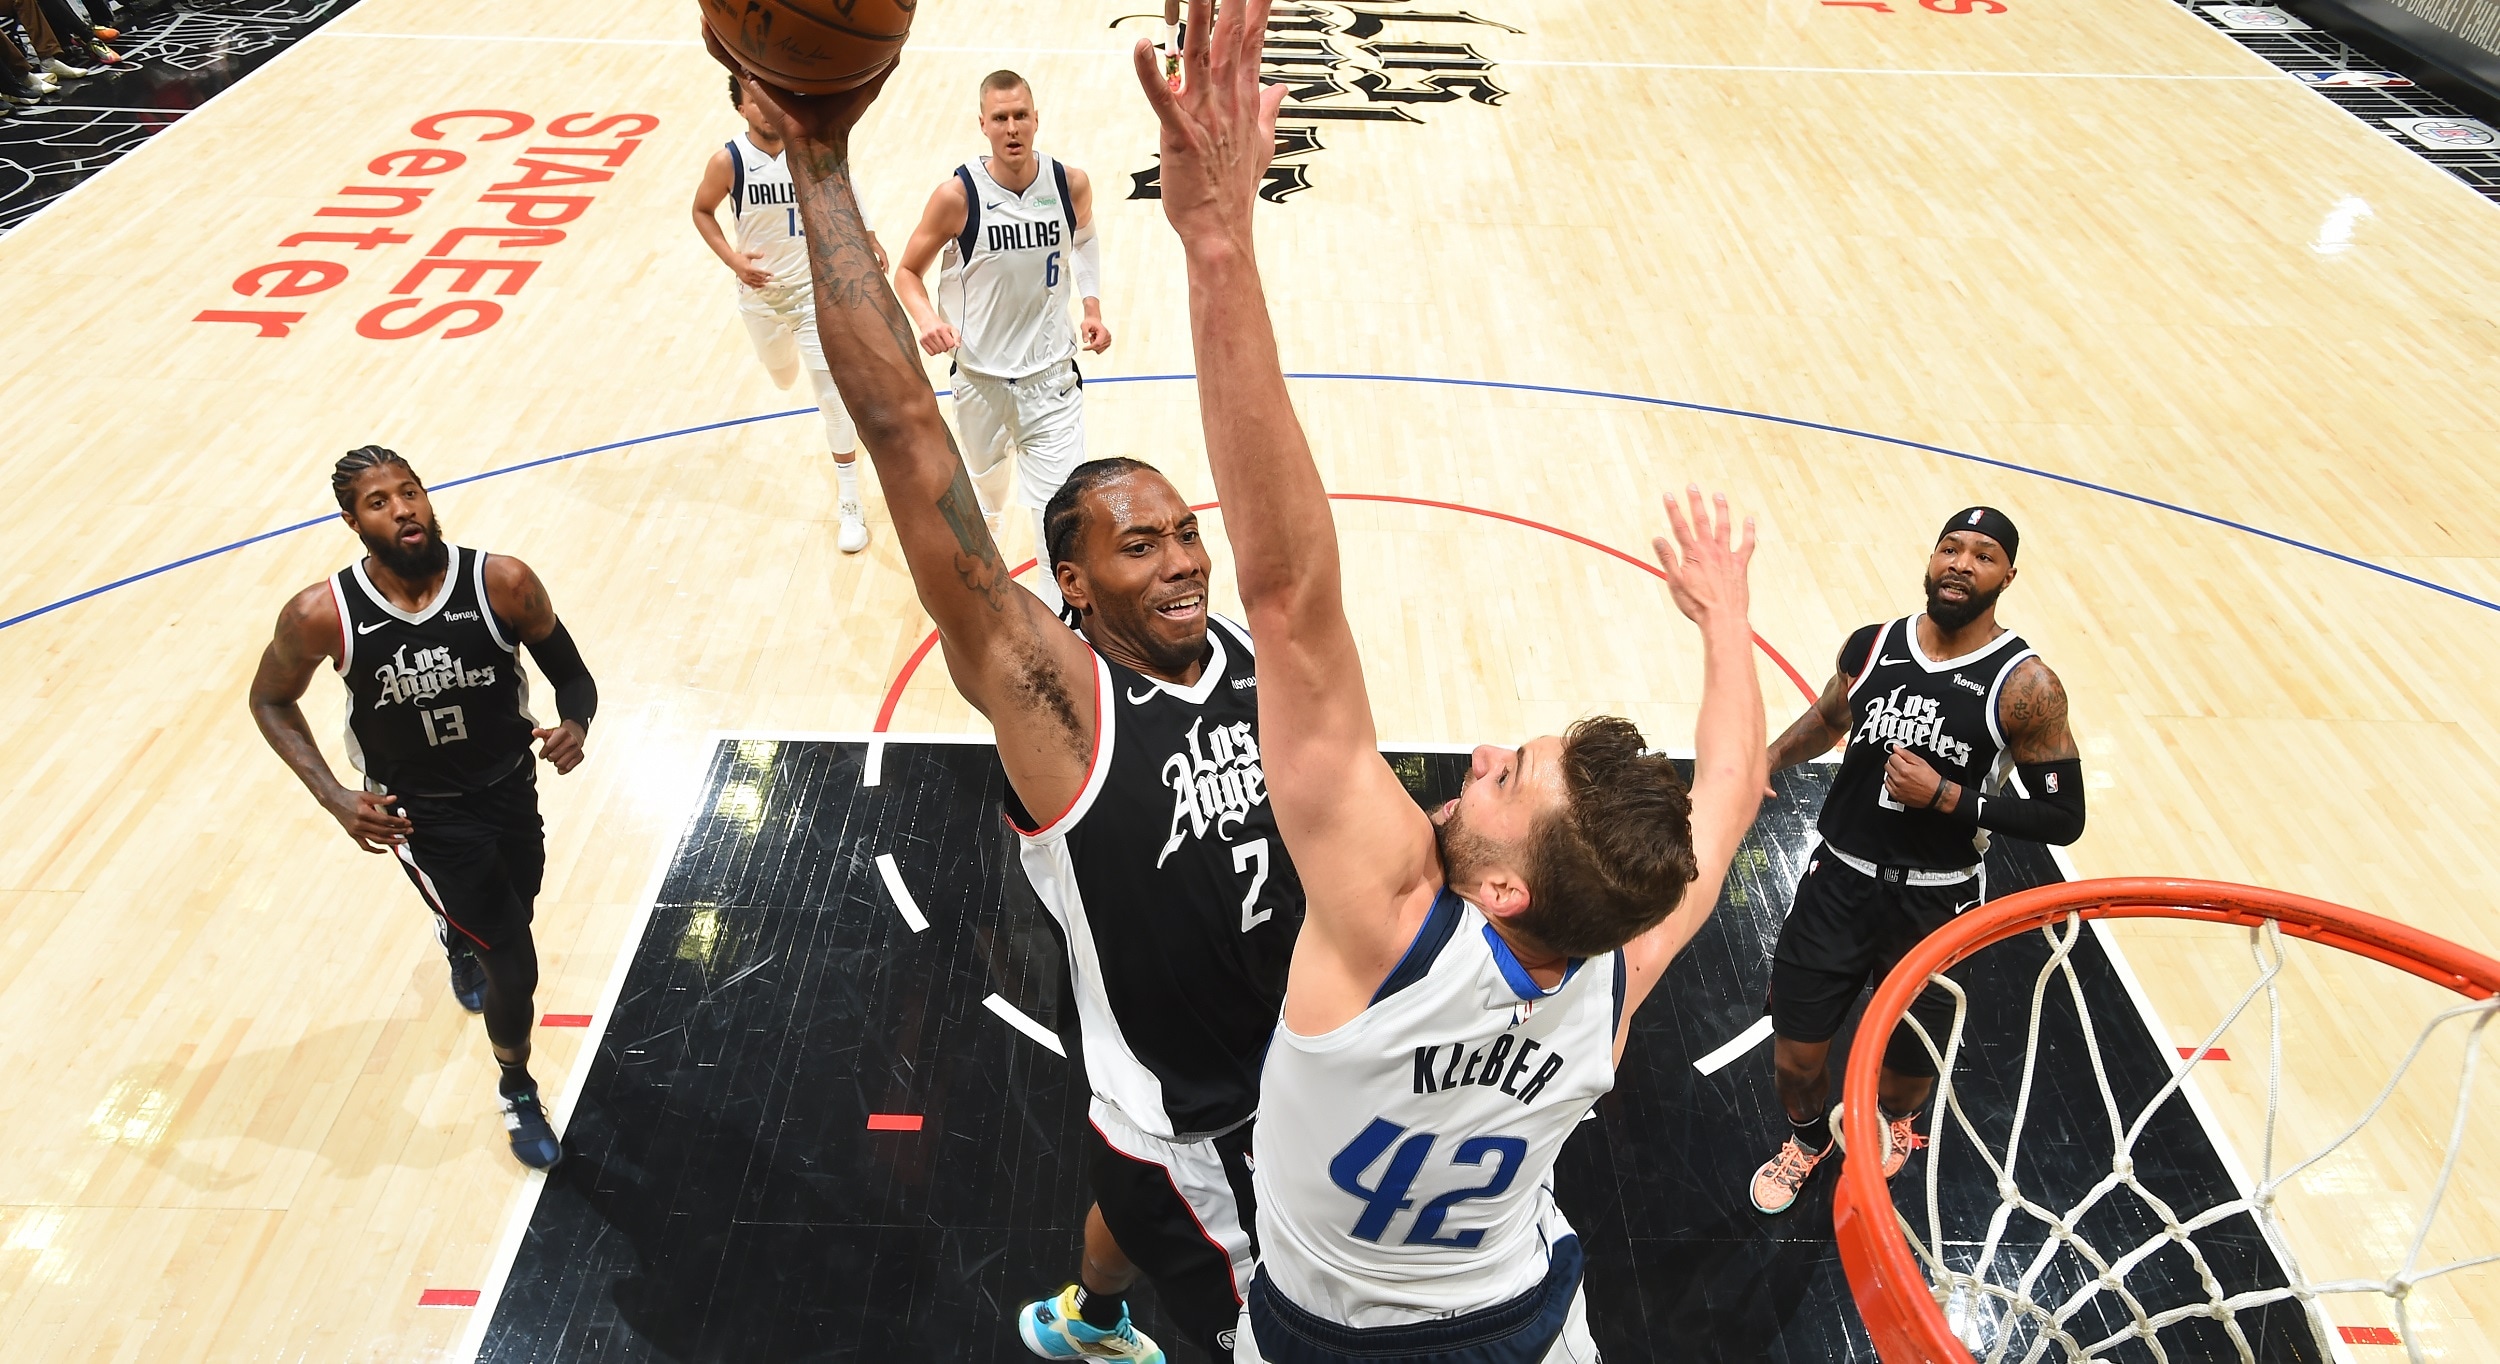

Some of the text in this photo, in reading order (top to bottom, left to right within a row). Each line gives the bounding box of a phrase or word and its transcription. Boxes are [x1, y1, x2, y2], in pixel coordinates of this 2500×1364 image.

[748, 182, 799, 205] DALLA
[191, 109, 535, 338] Center
[355, 111, 660, 340] STAPLES
[987, 220, 1060, 252] DALLAS
[1046, 250, 1061, 288] 6
[443, 609, 480, 623] honey
[374, 656, 496, 711] Angeles
[392, 643, 453, 679] Los
[1953, 672, 1986, 697] honey
[420, 704, 468, 747] 13
[1882, 683, 1941, 725] Los
[1184, 715, 1260, 780] Los
[1850, 696, 1973, 768] Angeles
[1156, 751, 1269, 870] Ange
[1231, 837, 1273, 933] 2
[1413, 1033, 1564, 1106] KLEBER
[1328, 1115, 1530, 1250] 42
